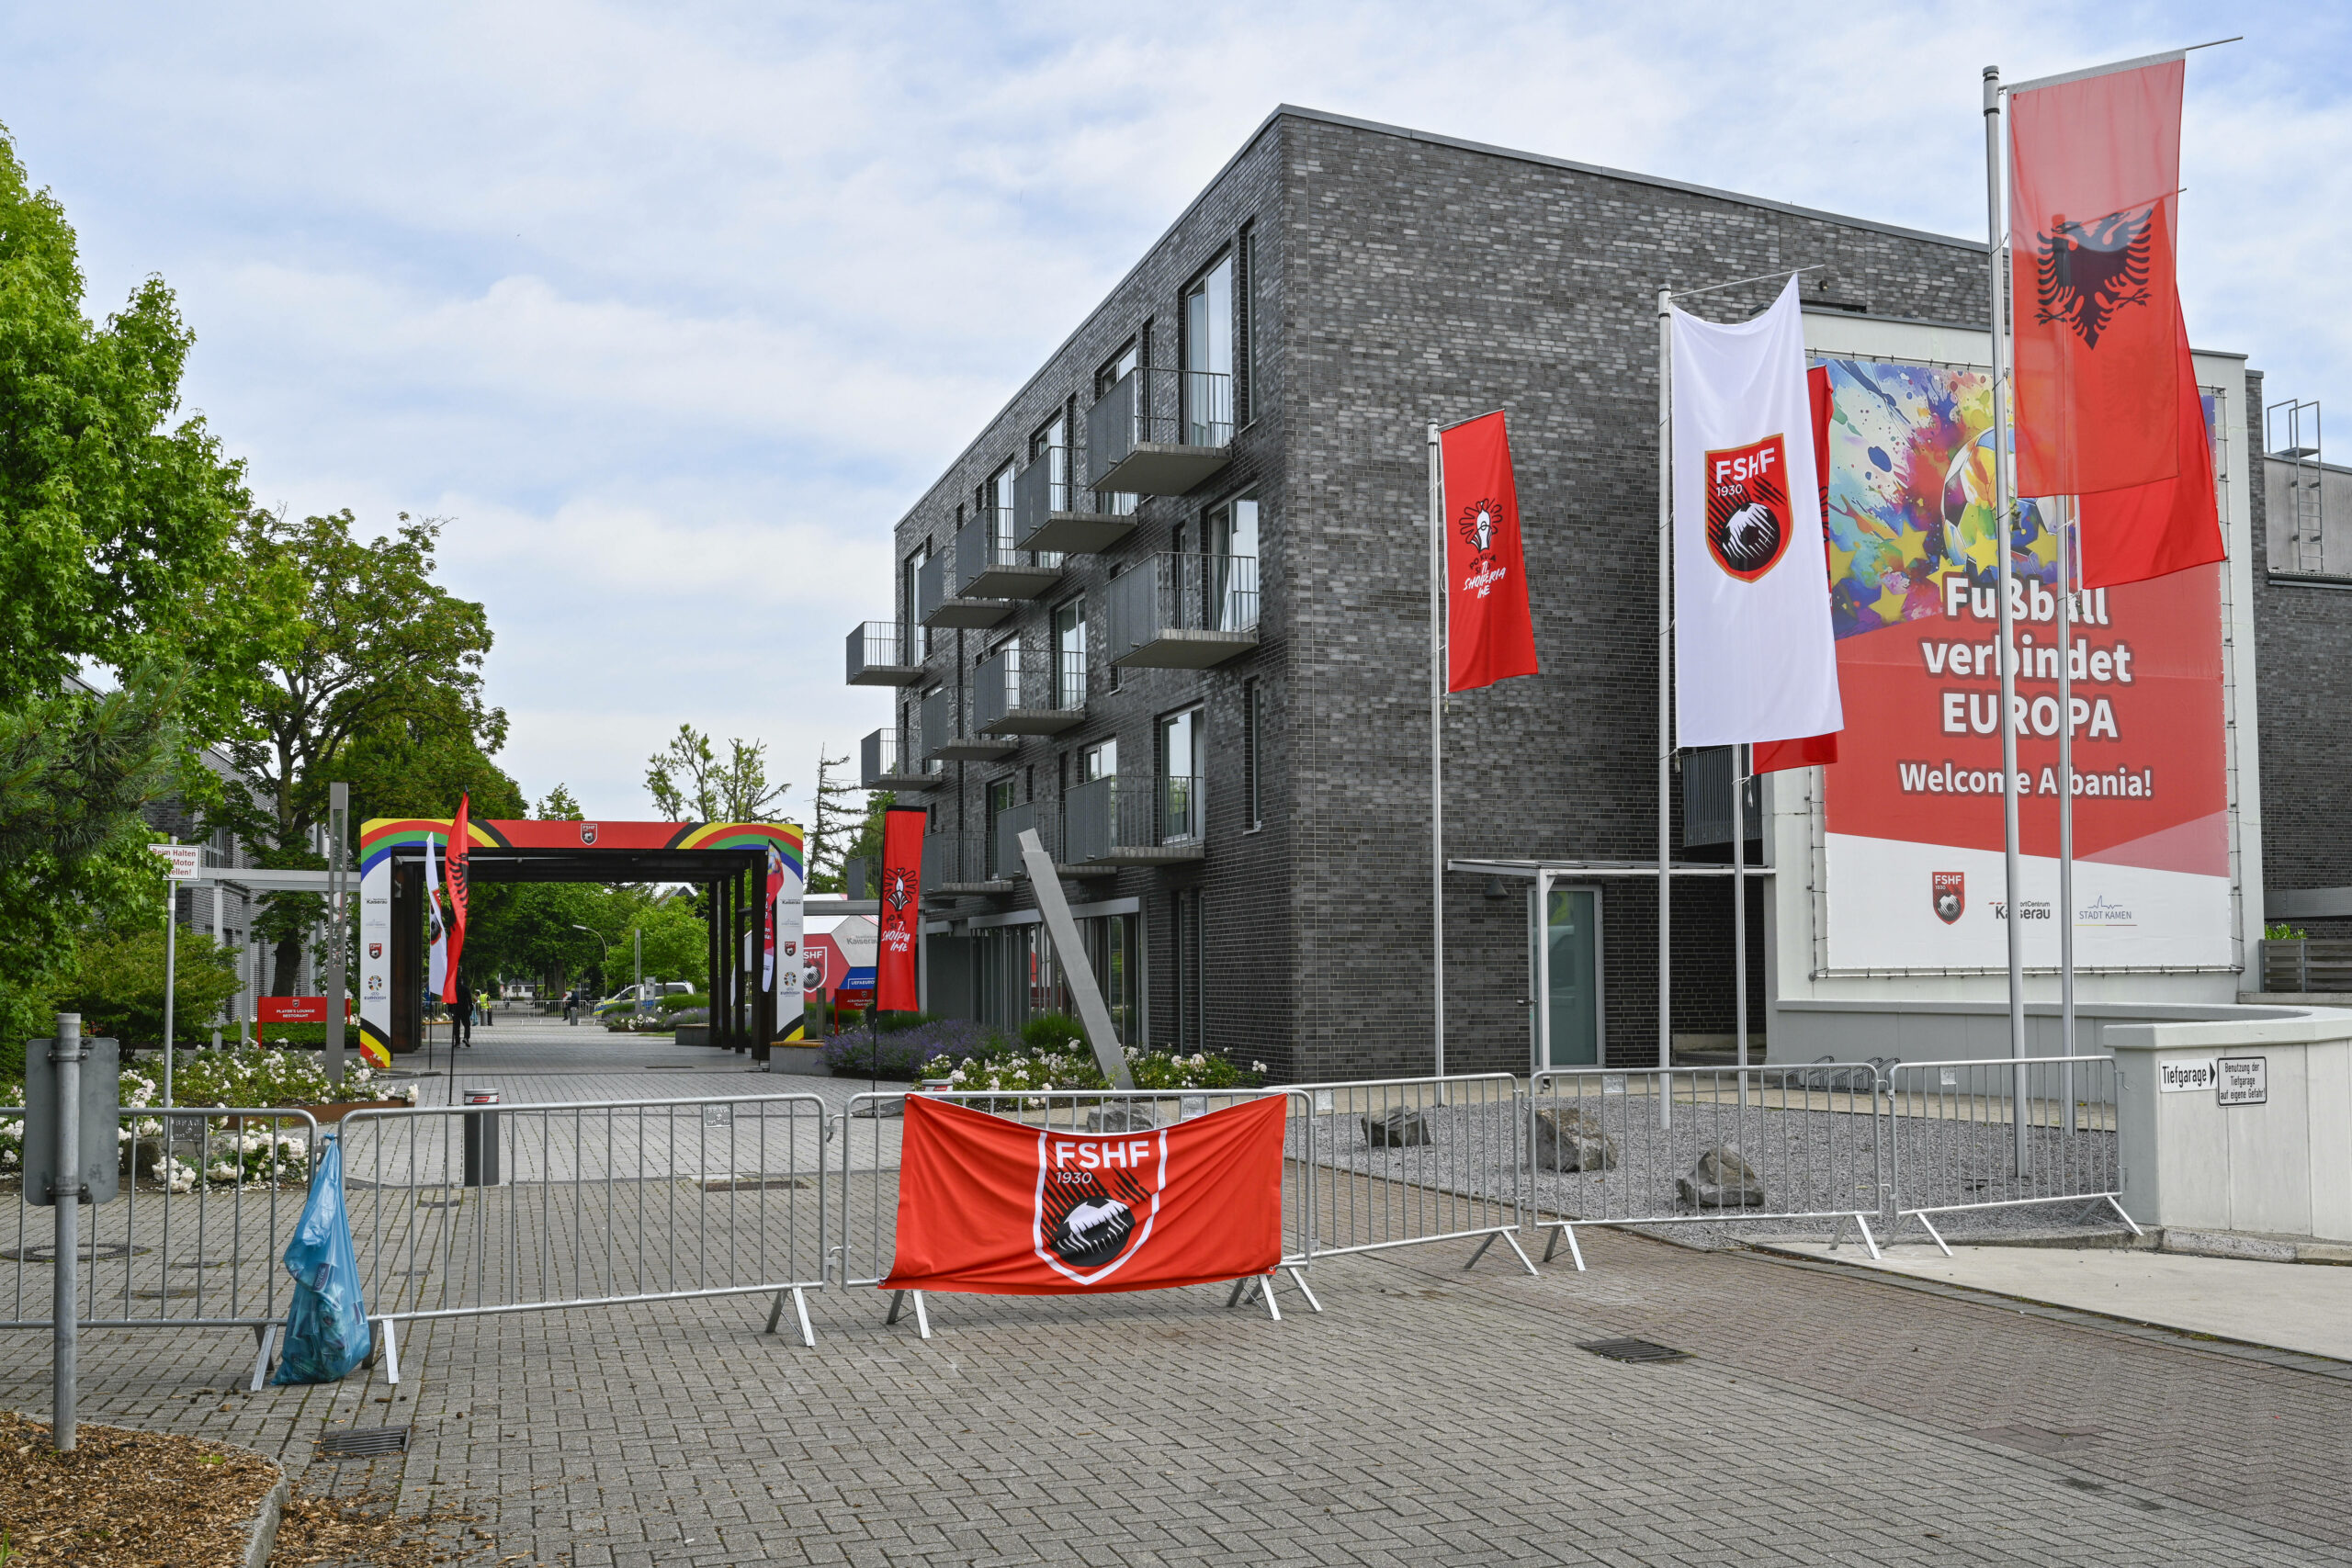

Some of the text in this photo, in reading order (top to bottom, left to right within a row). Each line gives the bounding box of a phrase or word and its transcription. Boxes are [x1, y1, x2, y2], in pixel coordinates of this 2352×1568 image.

[1715, 446, 1775, 484] FSHF
[1715, 483, 1743, 497] 1930
[1943, 693, 2119, 738] EUROPA
[2038, 767, 2153, 797] Abania!
[173, 849, 197, 857] Halten
[173, 858, 196, 866] Motor
[1935, 874, 1962, 886] FSHF
[2079, 910, 2132, 919] STADT KAMEN
[889, 942, 908, 953] IME
[803, 950, 823, 960] SHF
[2224, 1062, 2260, 1075] Benutzung der
[2162, 1066, 2207, 1089] Tiefgarage
[2230, 1075, 2256, 1089] Tiefgarage
[2220, 1087, 2266, 1102] auf eigene Gefahr!
[1055, 1140, 1149, 1169] FSHF
[1056, 1171, 1092, 1184] 1930
